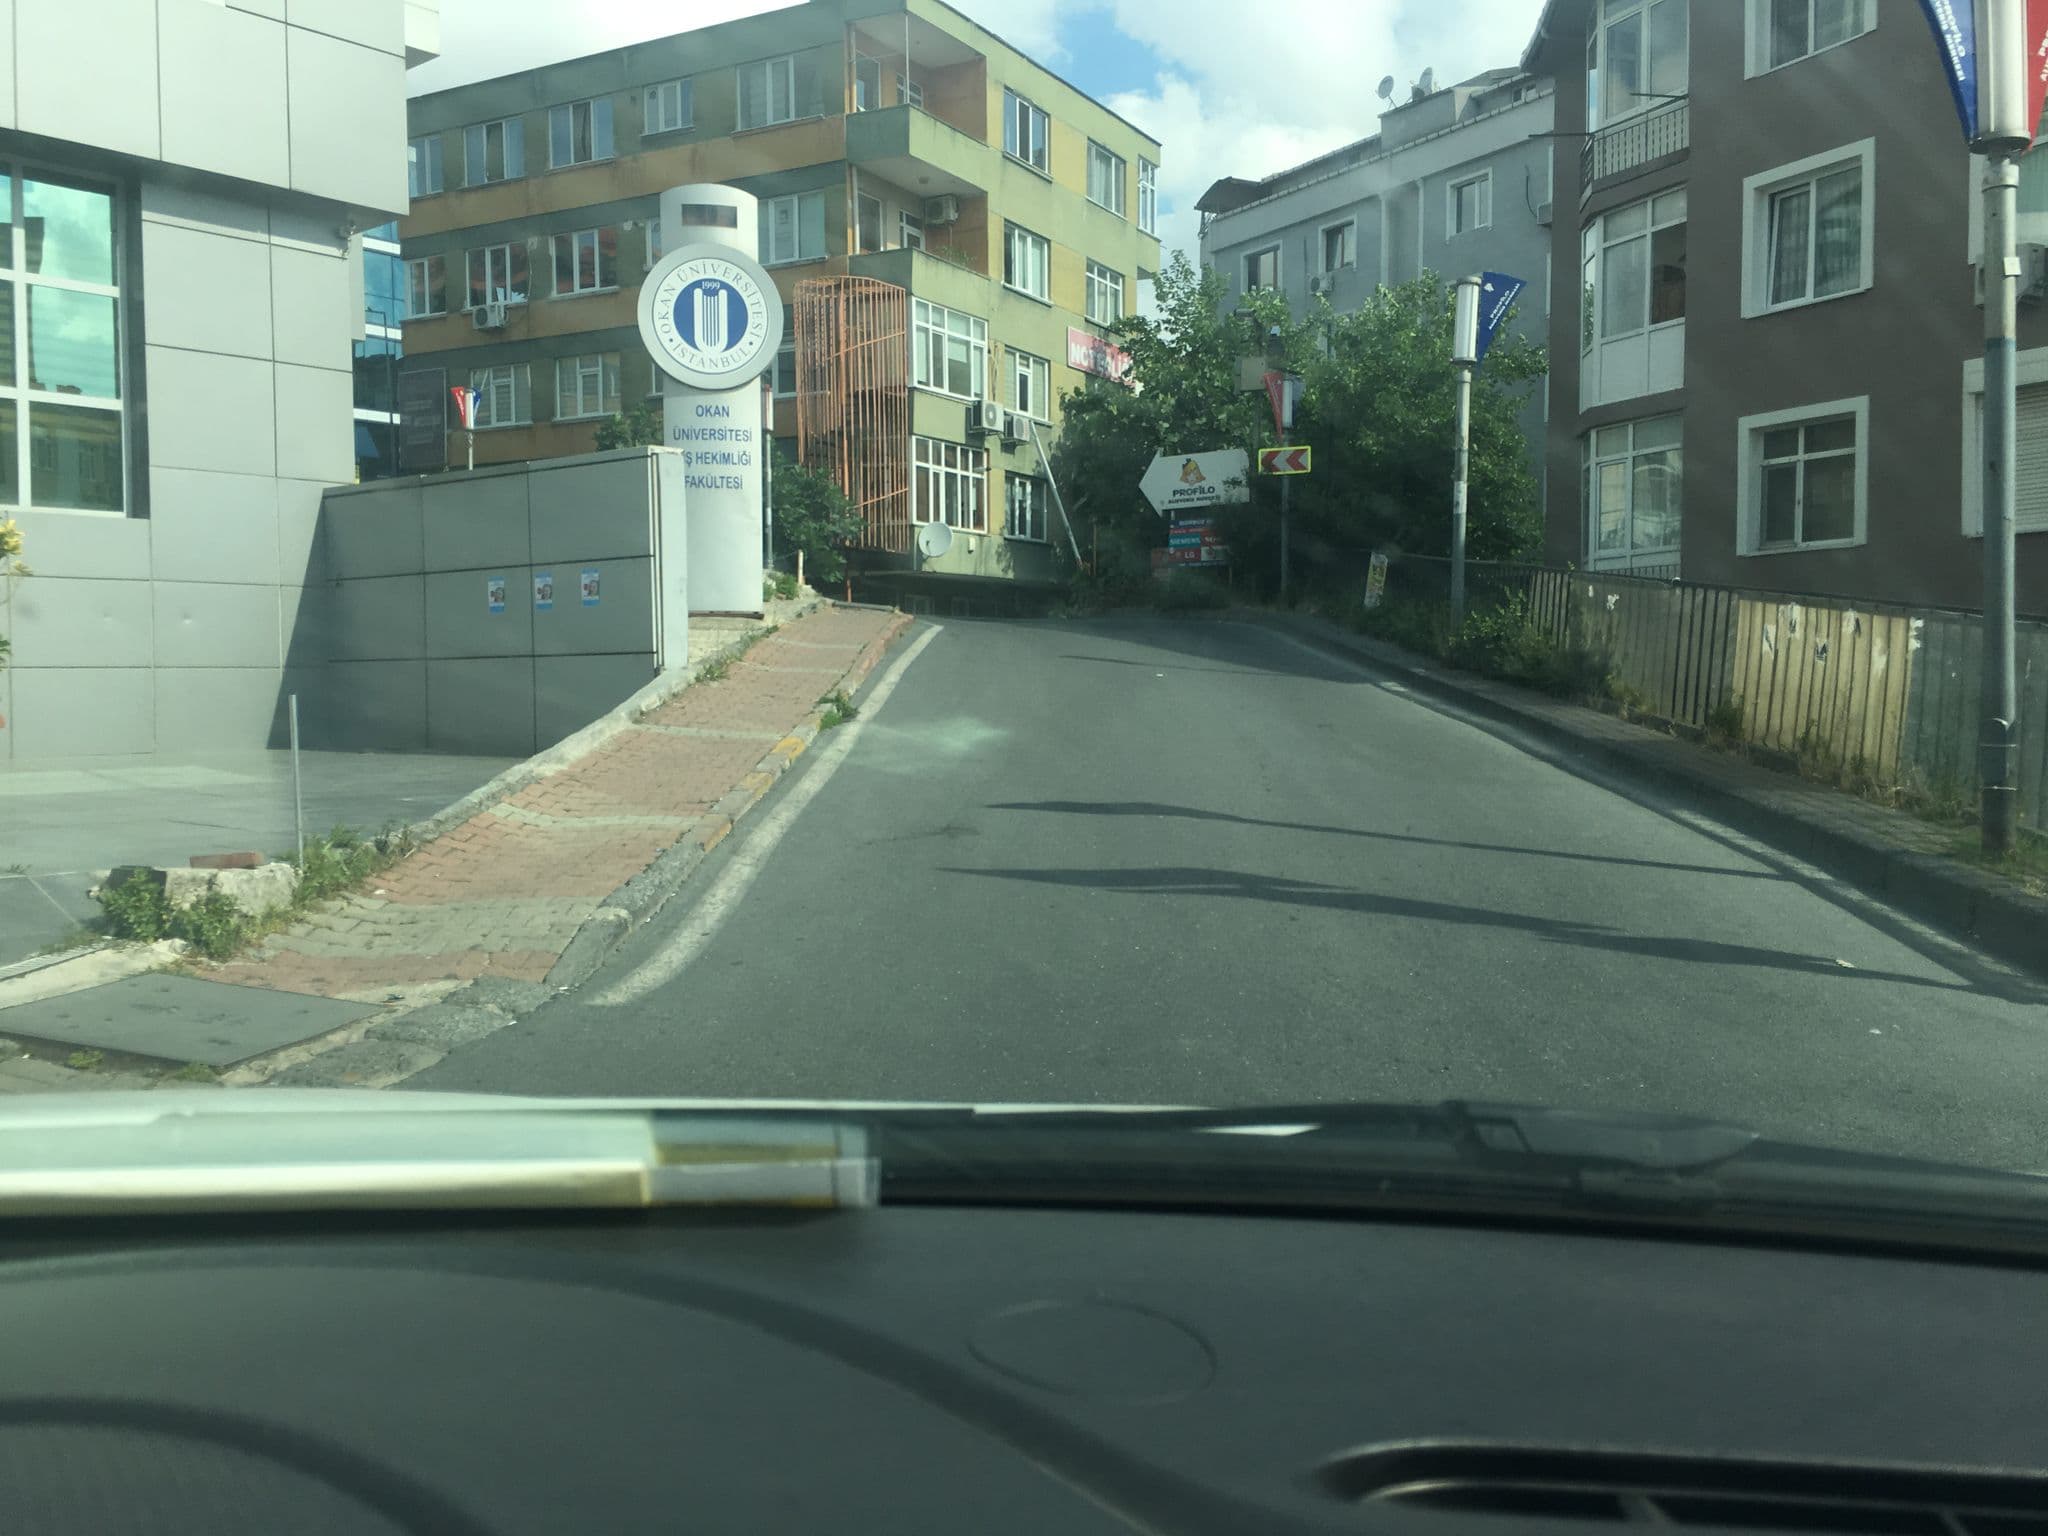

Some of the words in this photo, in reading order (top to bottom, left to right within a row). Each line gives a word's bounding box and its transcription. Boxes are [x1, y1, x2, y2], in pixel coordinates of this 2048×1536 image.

[701, 281, 721, 290] 1999
[658, 286, 676, 339] OKAN
[695, 404, 730, 418] OKAN
[672, 425, 753, 442] ÜNİVERSİTESİ
[695, 450, 752, 466] HEKİMLİĞİ
[684, 473, 743, 489] FAKÜLTESİ
[1172, 485, 1216, 498] PROFİLO
